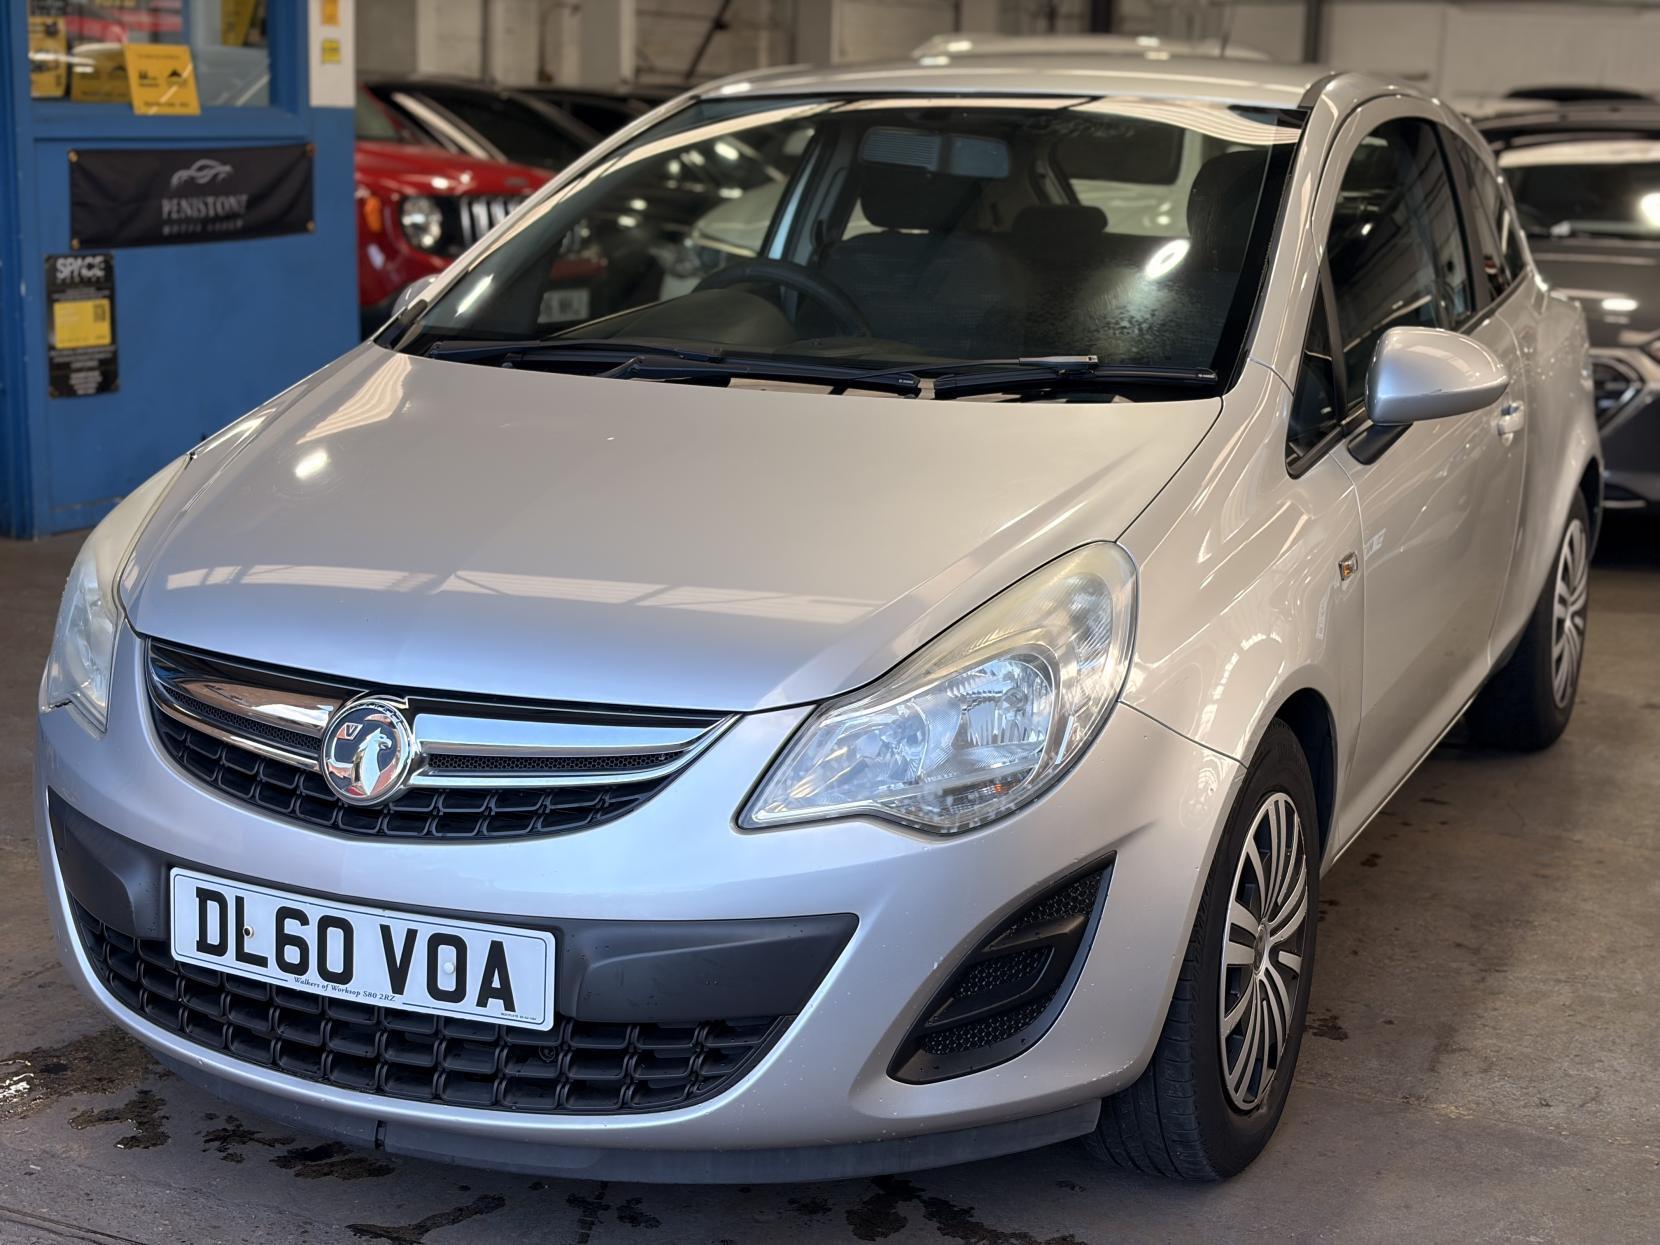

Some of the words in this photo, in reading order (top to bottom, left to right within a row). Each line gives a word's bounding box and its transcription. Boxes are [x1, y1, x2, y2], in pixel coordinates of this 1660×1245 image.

[195, 886, 355, 985] DL60
[379, 923, 516, 1013] VOA
[294, 976, 320, 988] Walkers
[321, 982, 330, 992] of
[331, 984, 361, 997] Worksop
[362, 990, 377, 999] S80
[379, 993, 396, 1002] 2RZ
